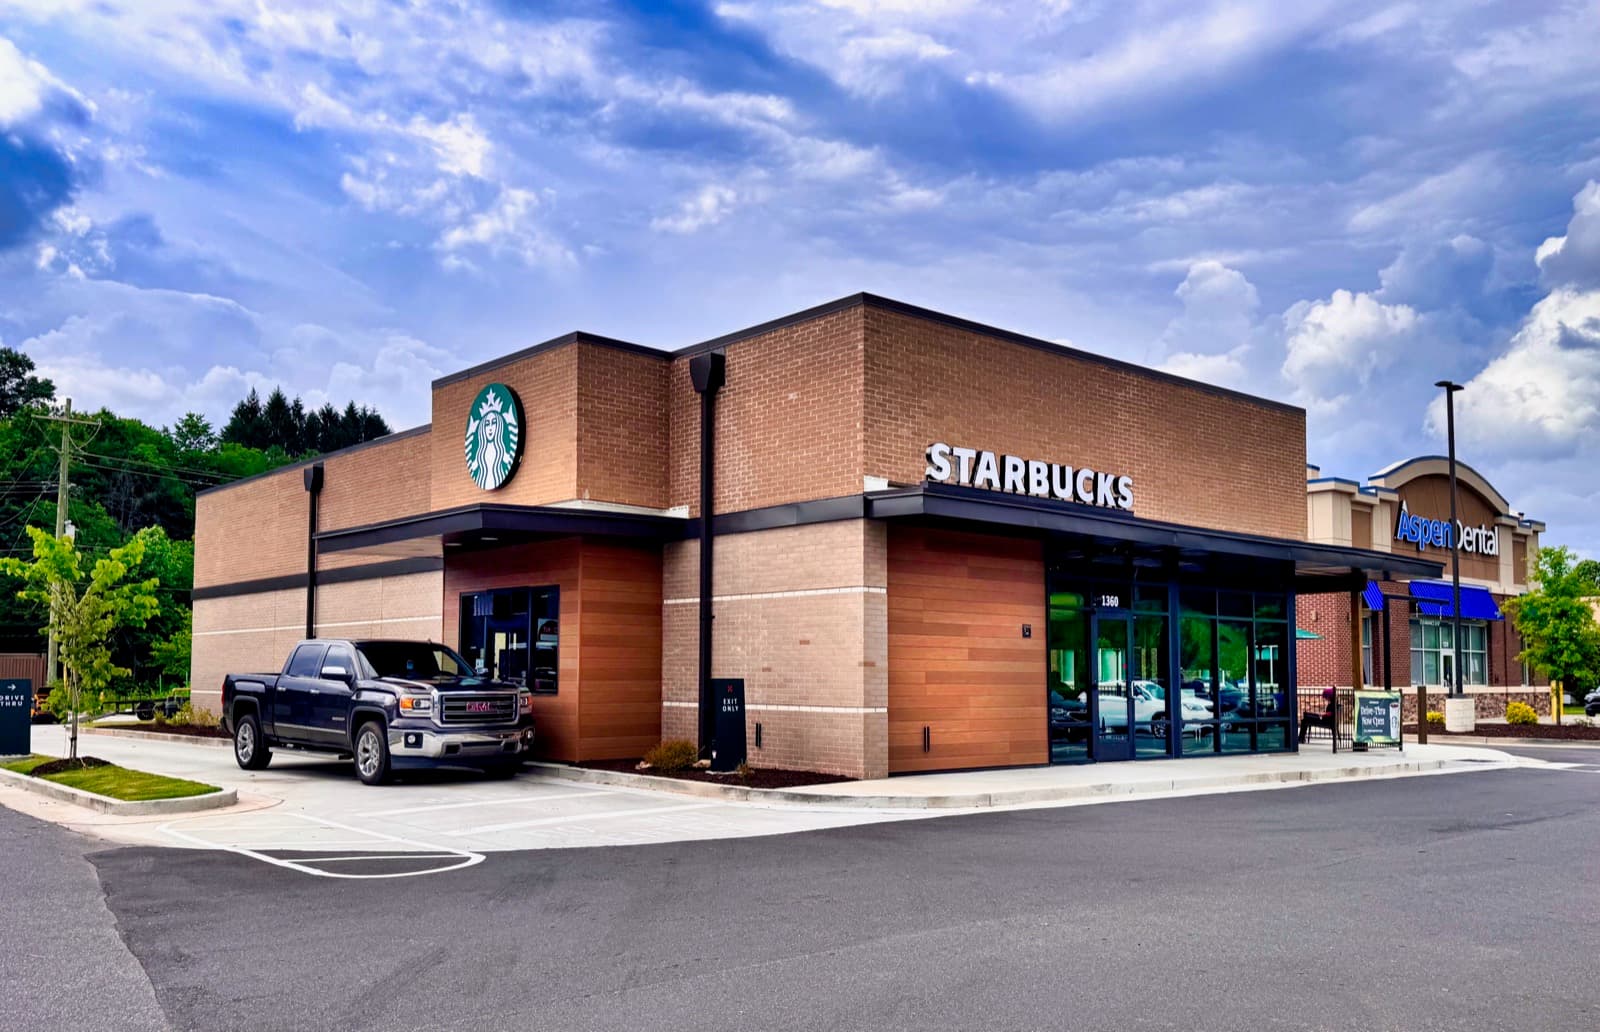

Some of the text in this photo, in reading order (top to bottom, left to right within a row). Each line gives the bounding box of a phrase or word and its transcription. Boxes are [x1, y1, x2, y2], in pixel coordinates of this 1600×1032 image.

[926, 442, 1135, 509] STARBUCKS
[1397, 500, 1499, 556] Aspen Dental
[1102, 595, 1119, 608] 1360
